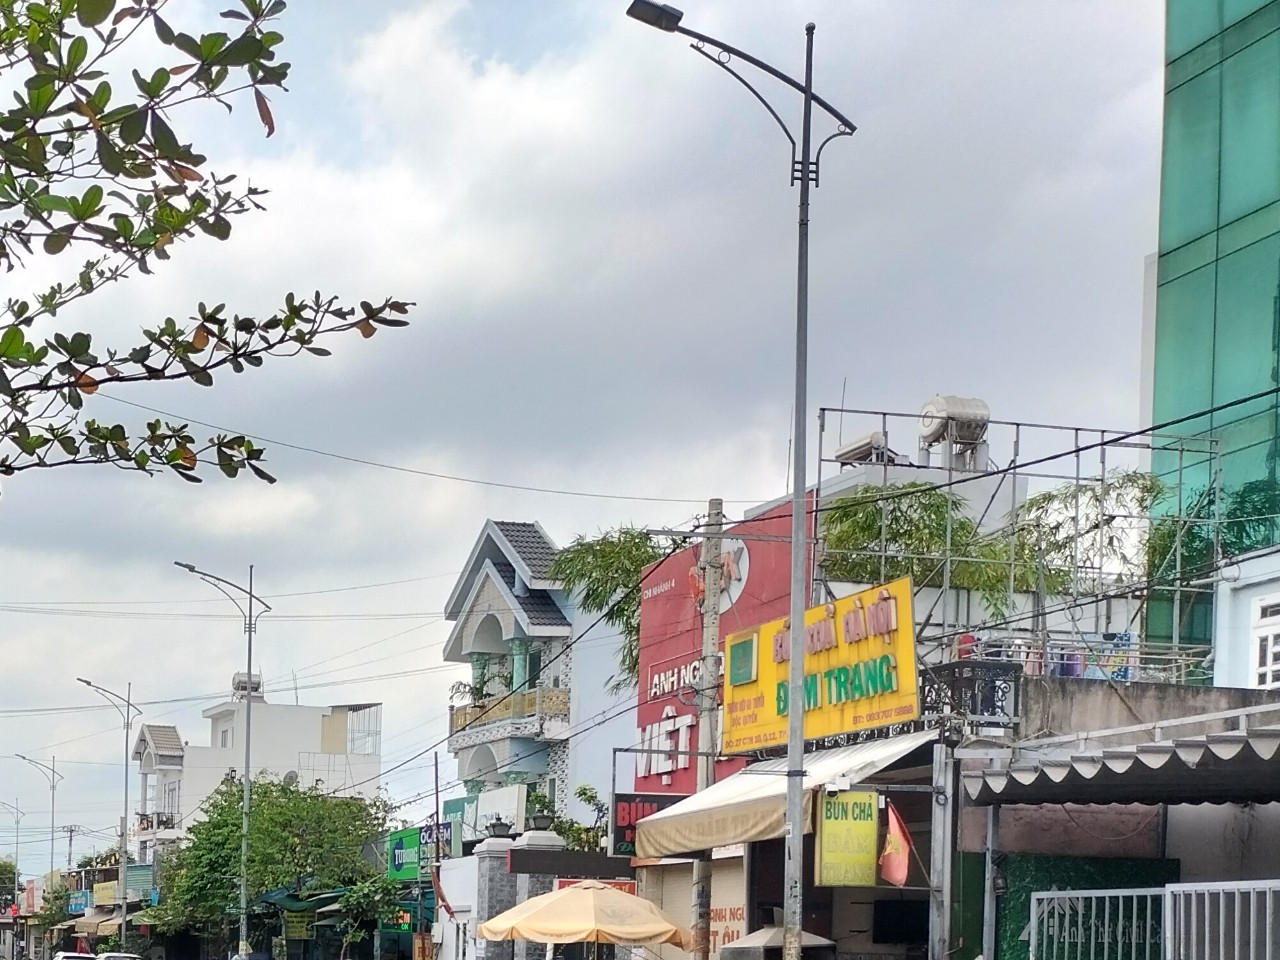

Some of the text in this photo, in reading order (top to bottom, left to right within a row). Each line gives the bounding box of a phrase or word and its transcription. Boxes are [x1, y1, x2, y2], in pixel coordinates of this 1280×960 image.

[842, 598, 868, 645] HÀ
[866, 588, 898, 645] NỘI
[651, 667, 679, 697] ANH
[776, 672, 822, 718] ĐM
[823, 653, 898, 706] TRANG
[636, 705, 697, 786] VIỆT
[825, 794, 873, 821] BÚN CHẢ
